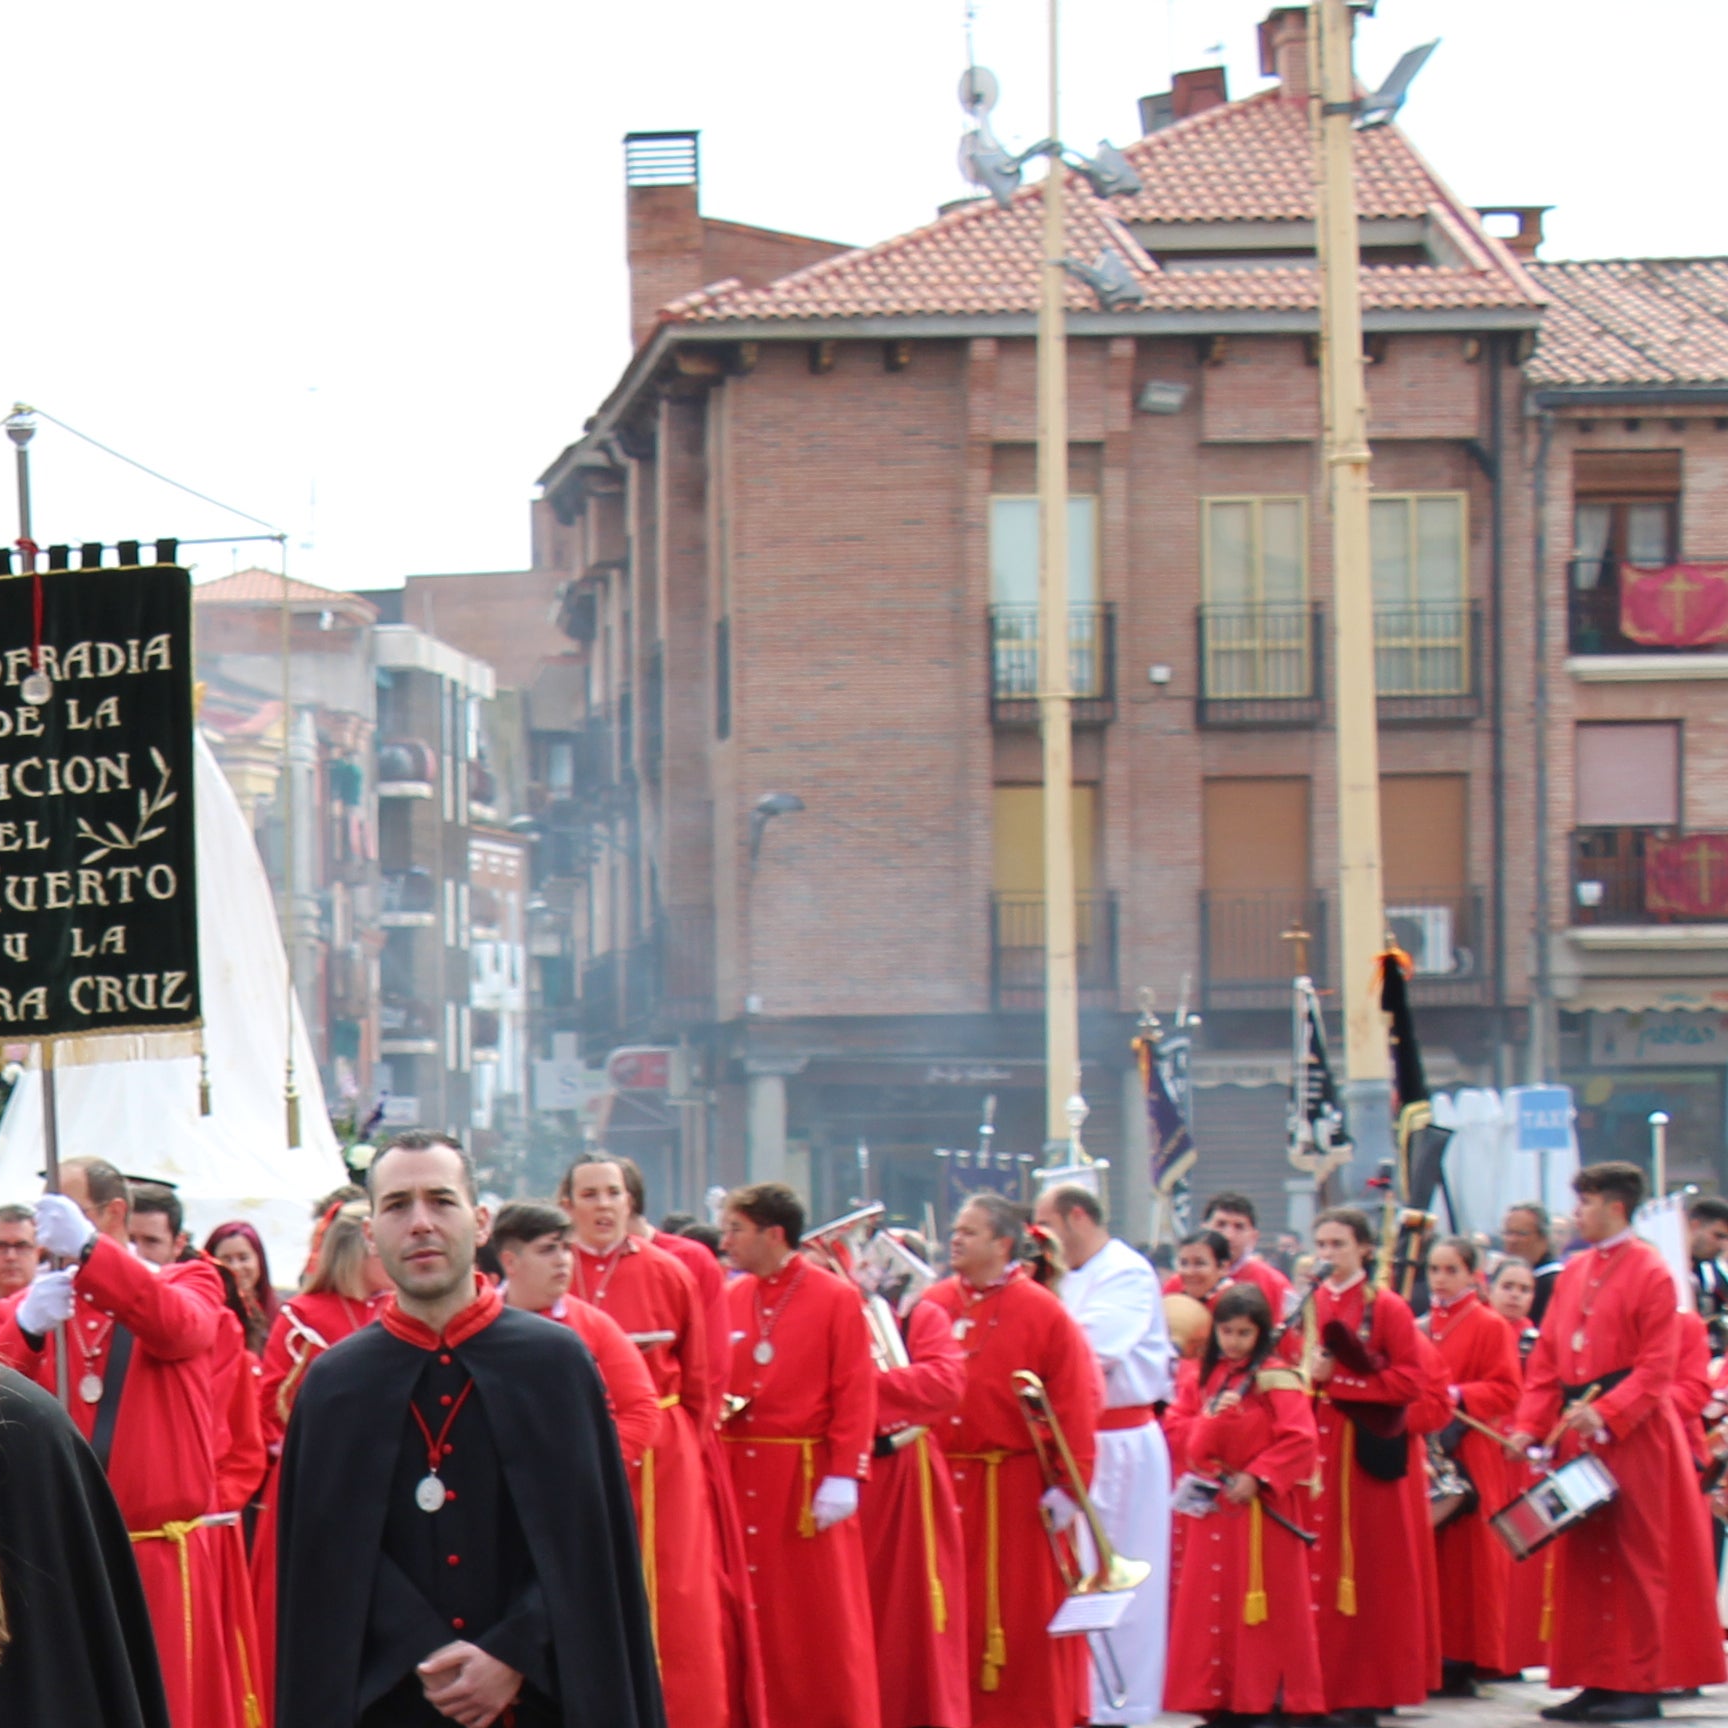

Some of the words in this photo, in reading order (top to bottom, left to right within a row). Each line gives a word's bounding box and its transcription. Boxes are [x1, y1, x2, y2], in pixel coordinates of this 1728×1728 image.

[66, 696, 123, 731] LA
[70, 925, 128, 958] LA
[68, 971, 193, 1015] CRUZ
